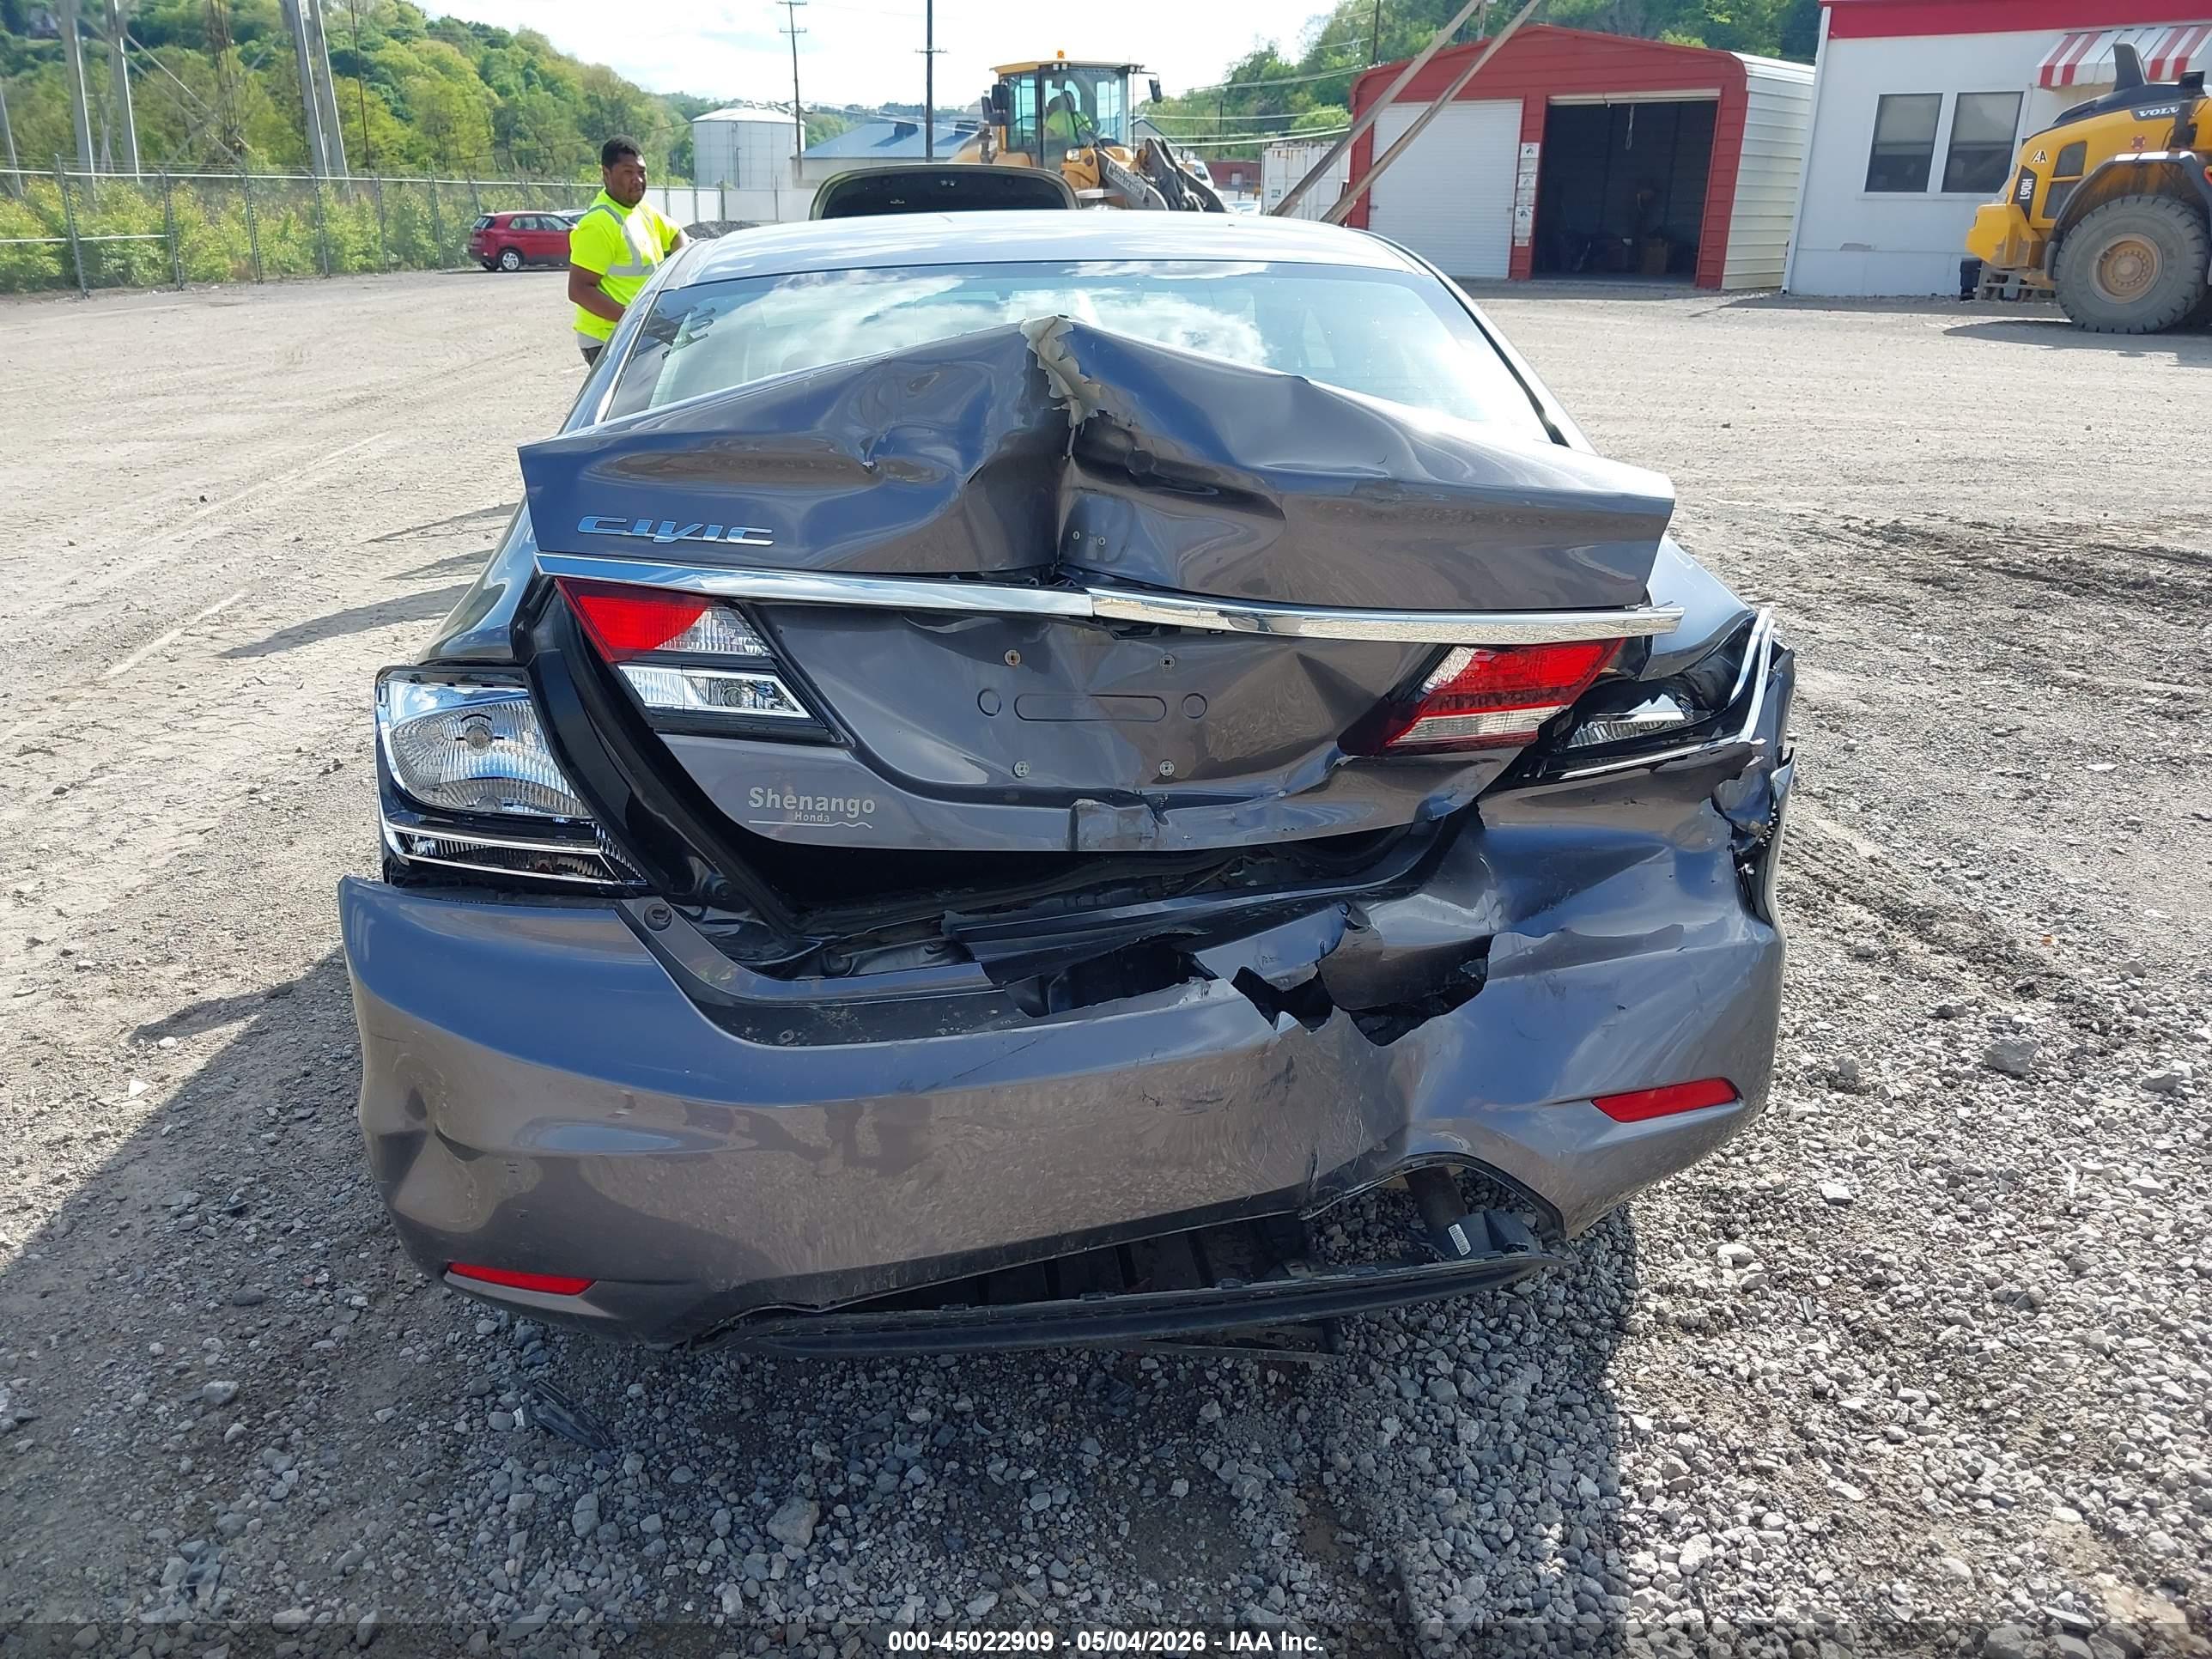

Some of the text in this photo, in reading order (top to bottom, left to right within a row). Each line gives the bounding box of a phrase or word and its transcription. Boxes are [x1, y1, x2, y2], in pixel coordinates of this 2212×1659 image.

[2138, 106, 2179, 117] VOLV
[2019, 178, 2033, 200] L90H
[577, 516, 774, 546] CIVIC
[748, 787, 876, 818] Shenango
[795, 811, 830, 823] Honda
